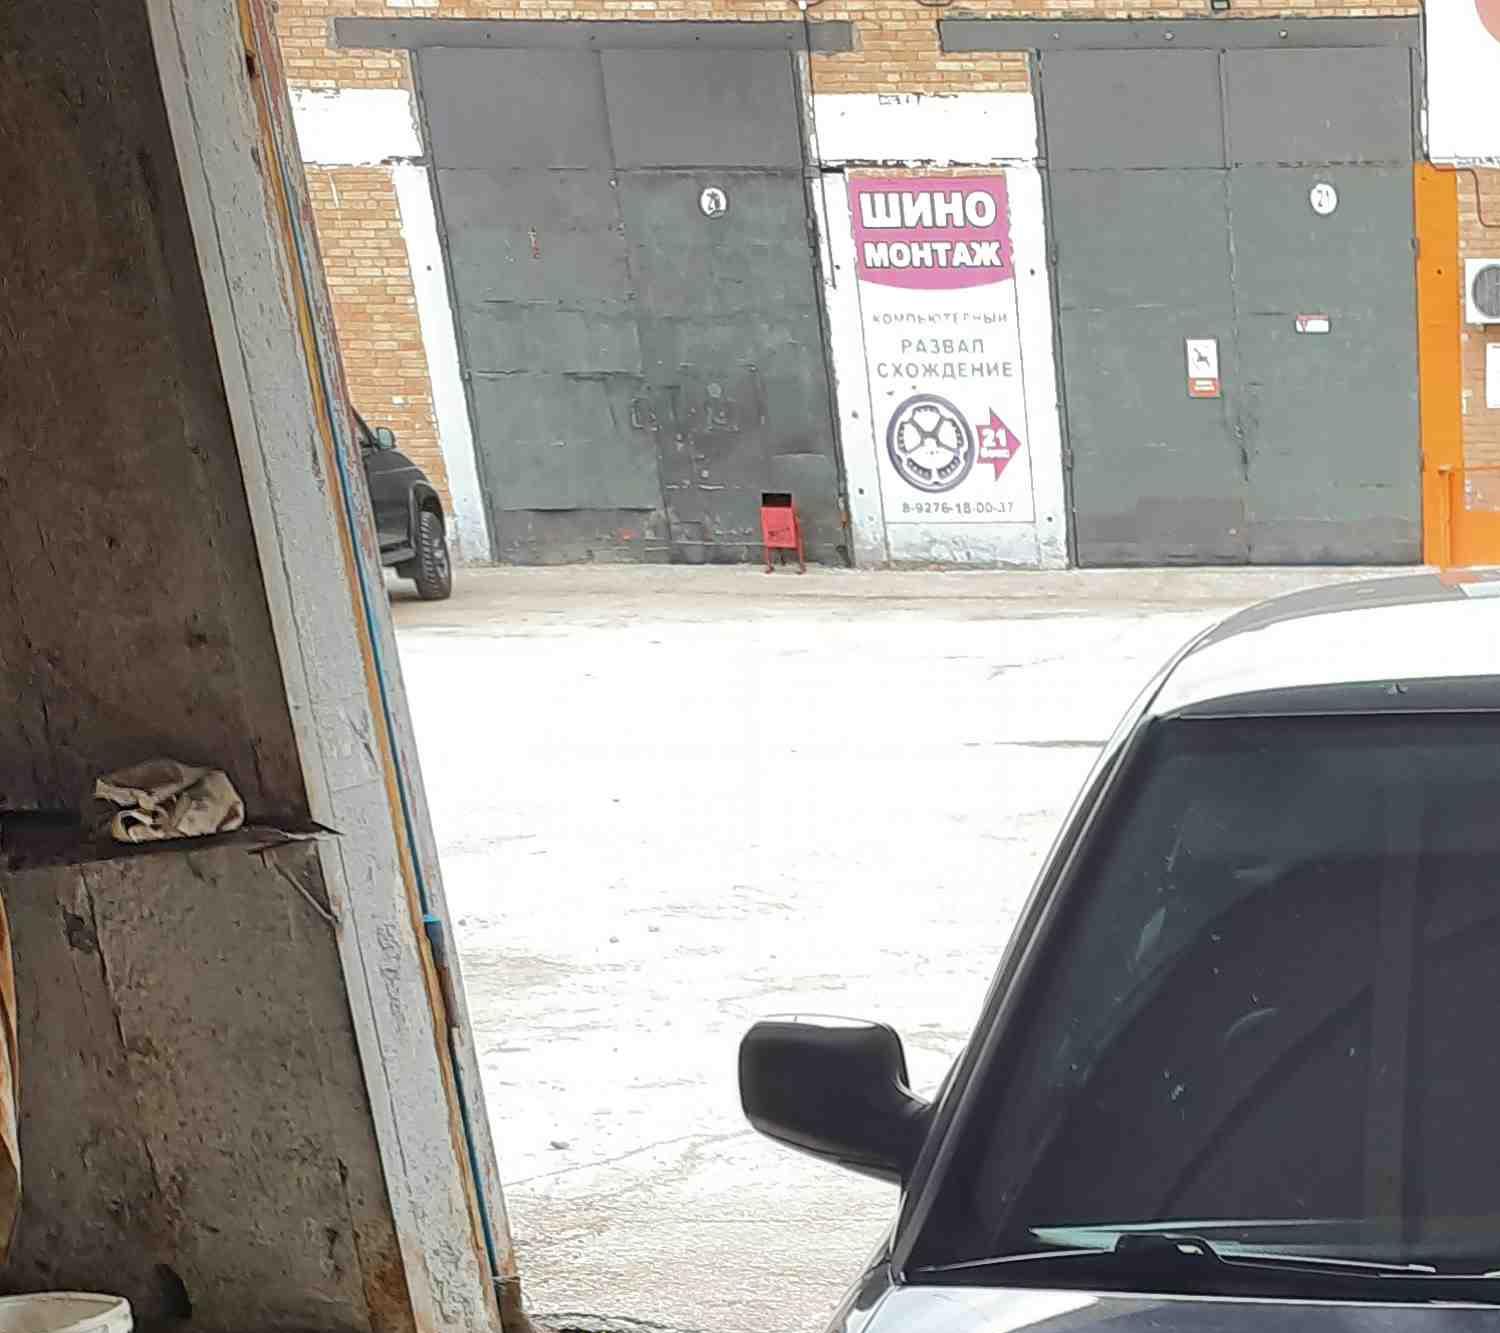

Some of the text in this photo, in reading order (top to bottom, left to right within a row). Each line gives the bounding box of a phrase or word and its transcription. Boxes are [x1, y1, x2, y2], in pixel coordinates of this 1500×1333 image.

[859, 190, 997, 228] ШИНО
[864, 240, 1004, 268] МОНТАЖ
[876, 361, 1014, 380] СХОЖДЕНИЕ
